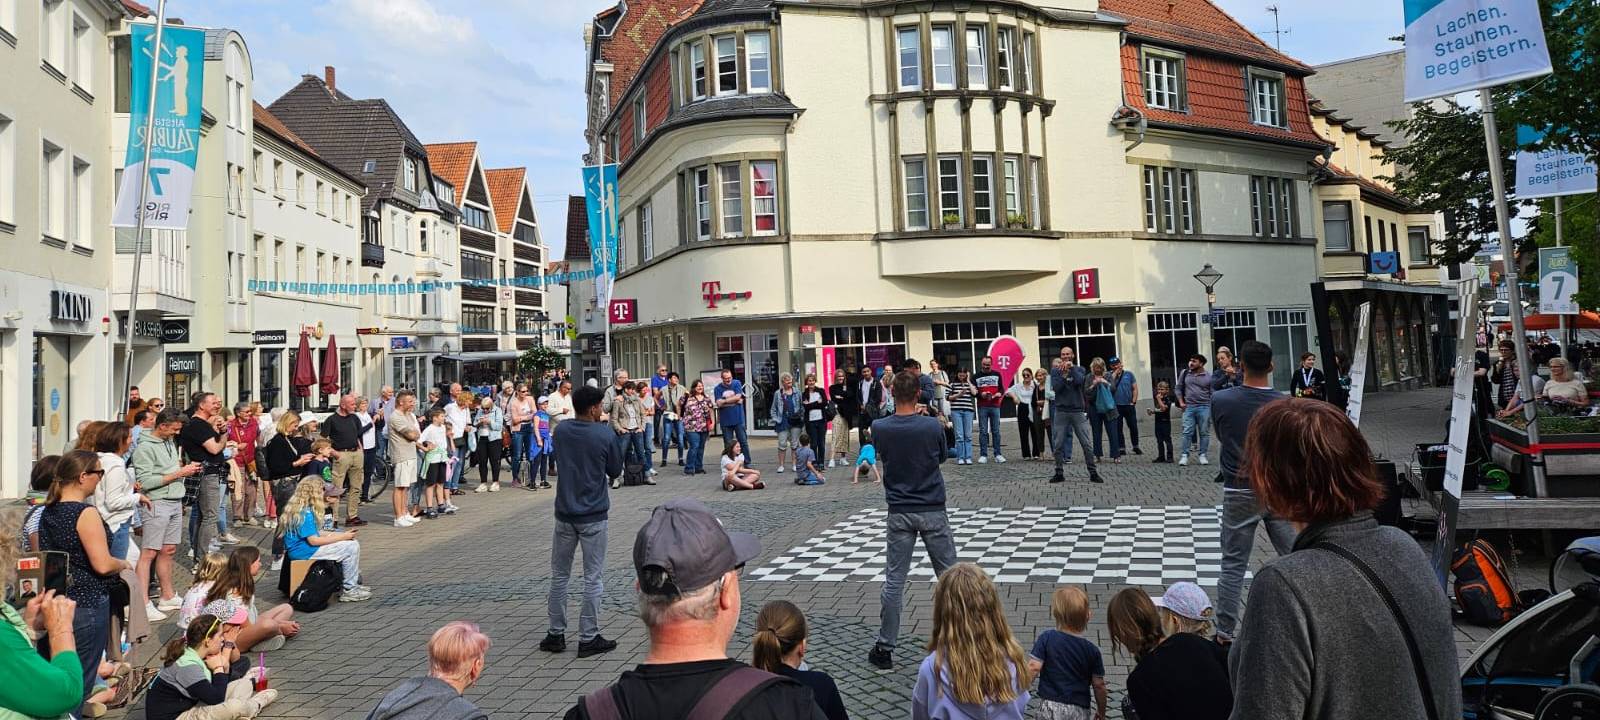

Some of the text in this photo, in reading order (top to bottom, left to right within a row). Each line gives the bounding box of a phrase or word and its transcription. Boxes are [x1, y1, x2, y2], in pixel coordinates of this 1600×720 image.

[1436, 7, 1508, 37] Lachen.
[1434, 24, 1518, 57] Staunen.
[1424, 37, 1537, 80] Begeistern.
[1552, 276, 1565, 300] 7
[56, 289, 94, 322] KIND
